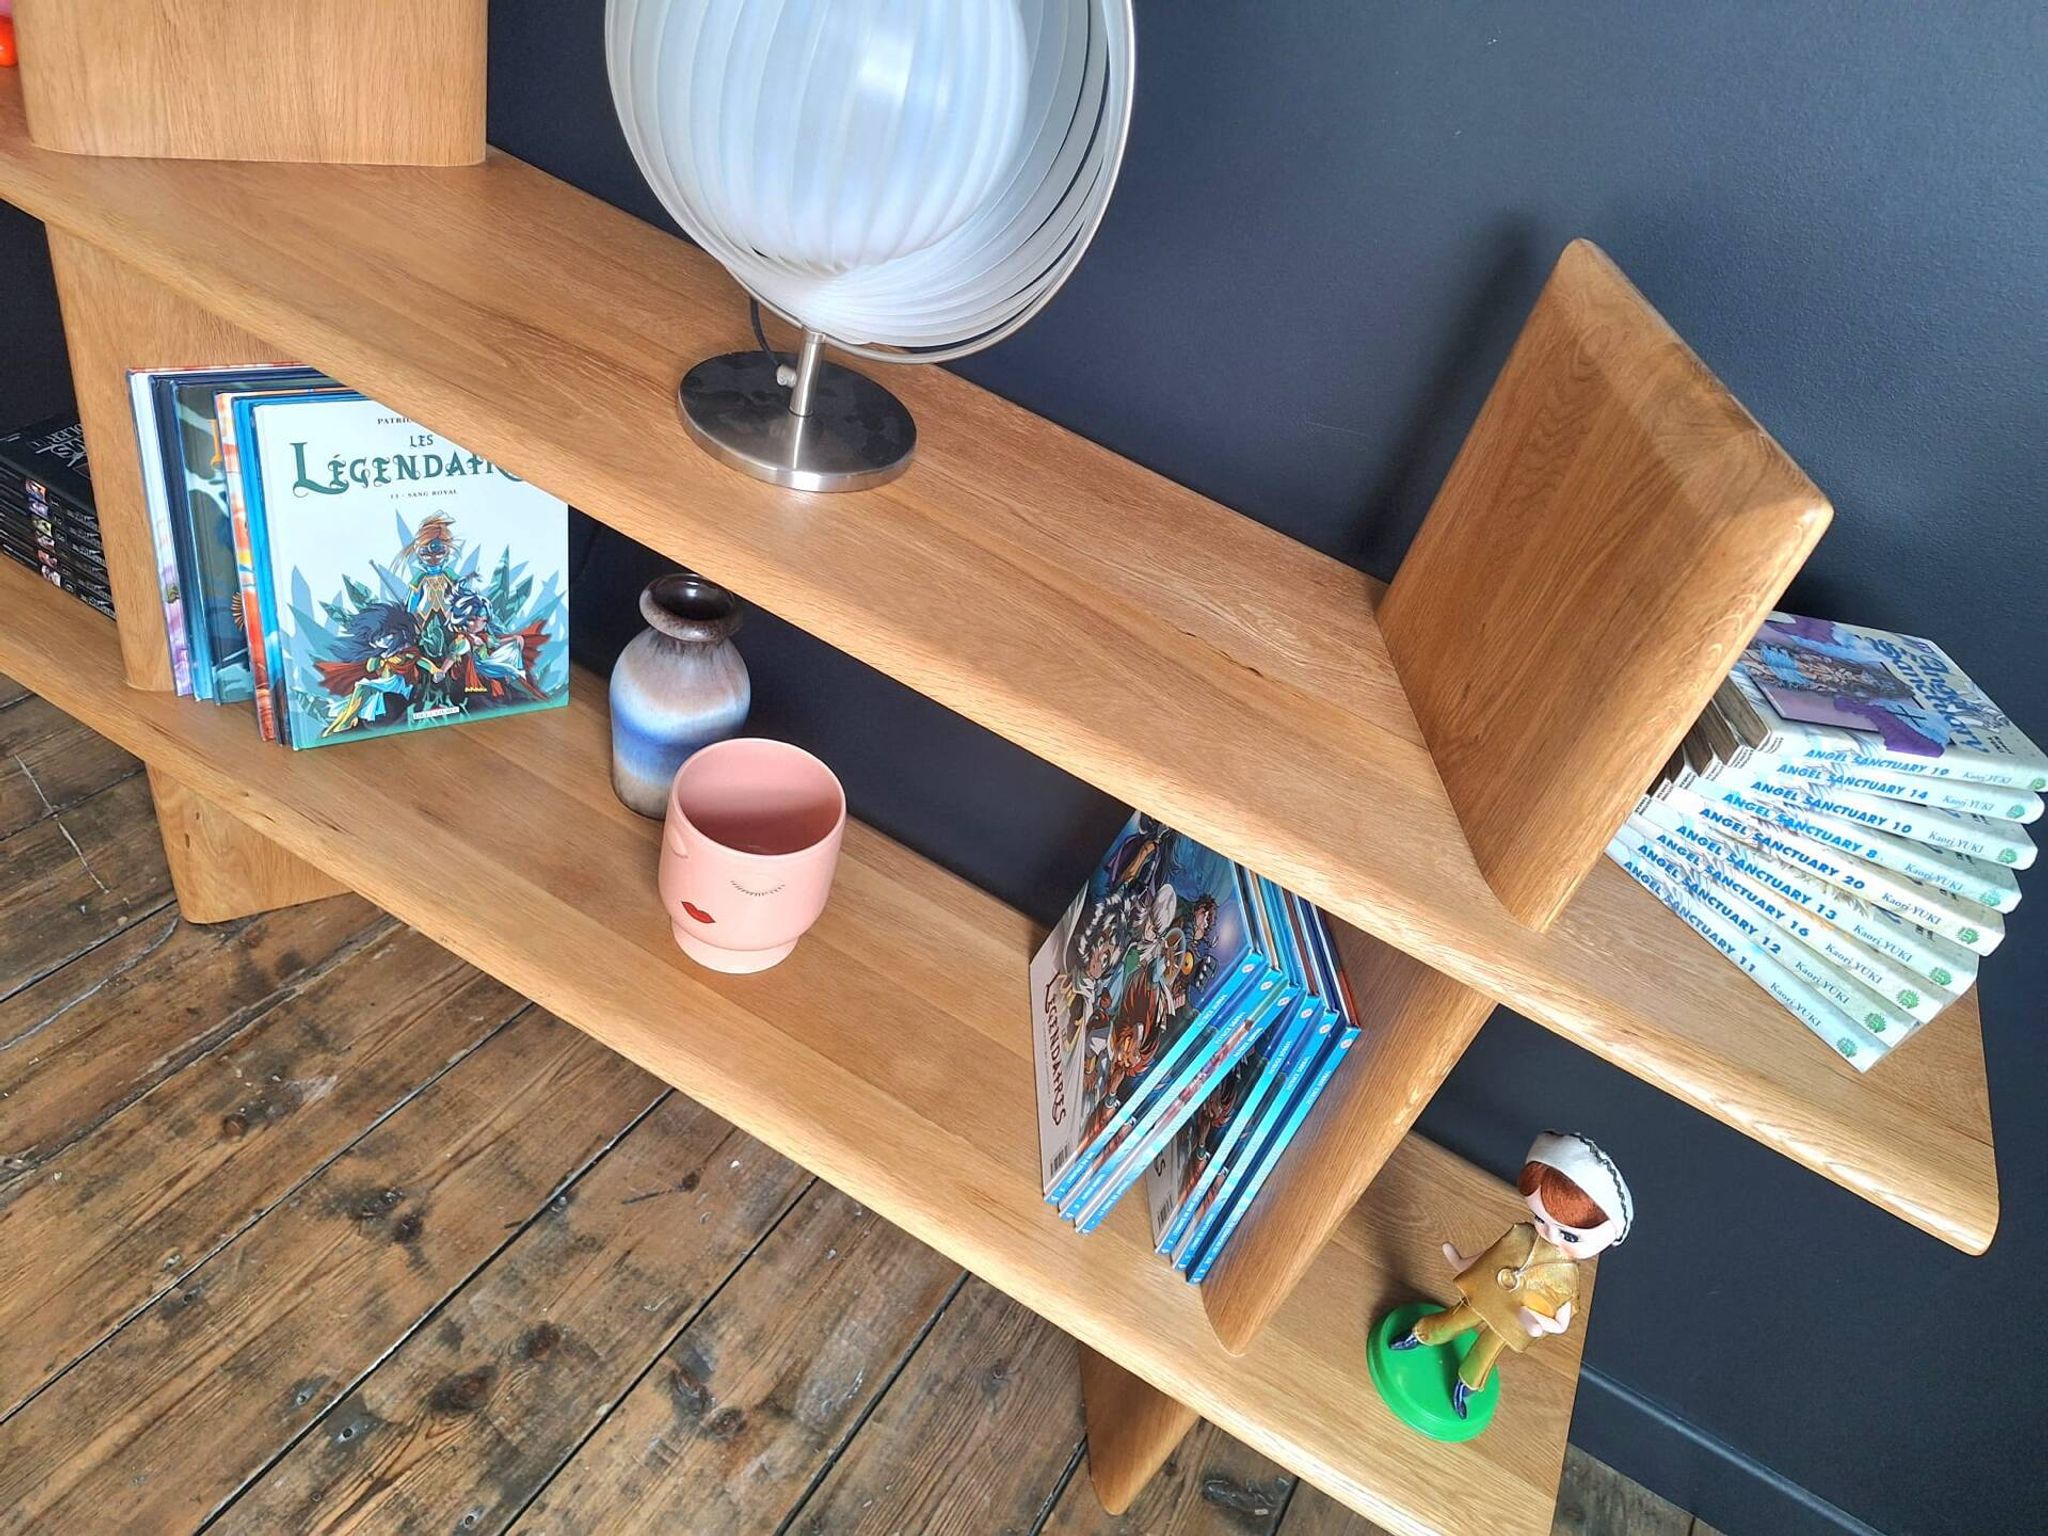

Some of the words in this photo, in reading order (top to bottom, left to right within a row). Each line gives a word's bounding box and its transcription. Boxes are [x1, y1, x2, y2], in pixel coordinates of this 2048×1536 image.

[289, 441, 525, 498] LÉGENDAI
[410, 434, 434, 448] LES
[1778, 764, 1821, 779] ANGEL
[1827, 773, 1908, 794] SANCTUARY
[1910, 789, 1928, 800] 14
[1942, 795, 1966, 808] Kaori
[1966, 800, 1995, 812] YUKI
[1804, 749, 1846, 762] ANGEL
[1852, 754, 1929, 775] SANCTUARY
[1700, 808, 1748, 835] ANGEL
[1752, 832, 1840, 876] SANCTUARY
[1842, 876, 1865, 889] 20
[1882, 892, 1912, 910] Kaori
[1912, 904, 1942, 926] YUKI
[1722, 794, 1770, 818] ANGEL
[1776, 814, 1862, 852] SANCTUARY
[1866, 849, 1878, 858] 8
[1904, 863, 1934, 878] Kaori
[1934, 874, 1964, 892] YUKI
[1751, 782, 1798, 800] ANGEL
[1803, 796, 1887, 826] SANCTUARY
[1892, 822, 1912, 833] 10
[1928, 830, 1955, 846] Kaori
[1954, 838, 1984, 854] YUKI
[1638, 844, 1680, 878] ANGEL
[1682, 875, 1758, 936] SANCTUARY
[1762, 936, 1782, 954] 12
[1795, 962, 1822, 986] Kaori
[1822, 980, 1850, 1004] YUKI
[1656, 834, 1700, 866] ANGEL
[1704, 864, 1786, 920] SANCTUARY
[1789, 920, 1810, 937] 16
[1825, 944, 1854, 968] Kaori
[1855, 961, 1884, 984] YUKI
[1676, 825, 1722, 856] ANGEL
[1726, 851, 1812, 904] SANCTUARY
[1816, 904, 1838, 920] 13
[1854, 924, 1880, 946] Kaori
[1884, 940, 1913, 962] YUKI
[1624, 861, 1662, 895] ANGEL
[1664, 894, 1736, 955] SANCTUARY
[1739, 956, 1756, 972] 11
[1770, 982, 1796, 1006] Kaori
[1795, 1003, 1822, 1028] YUKI
